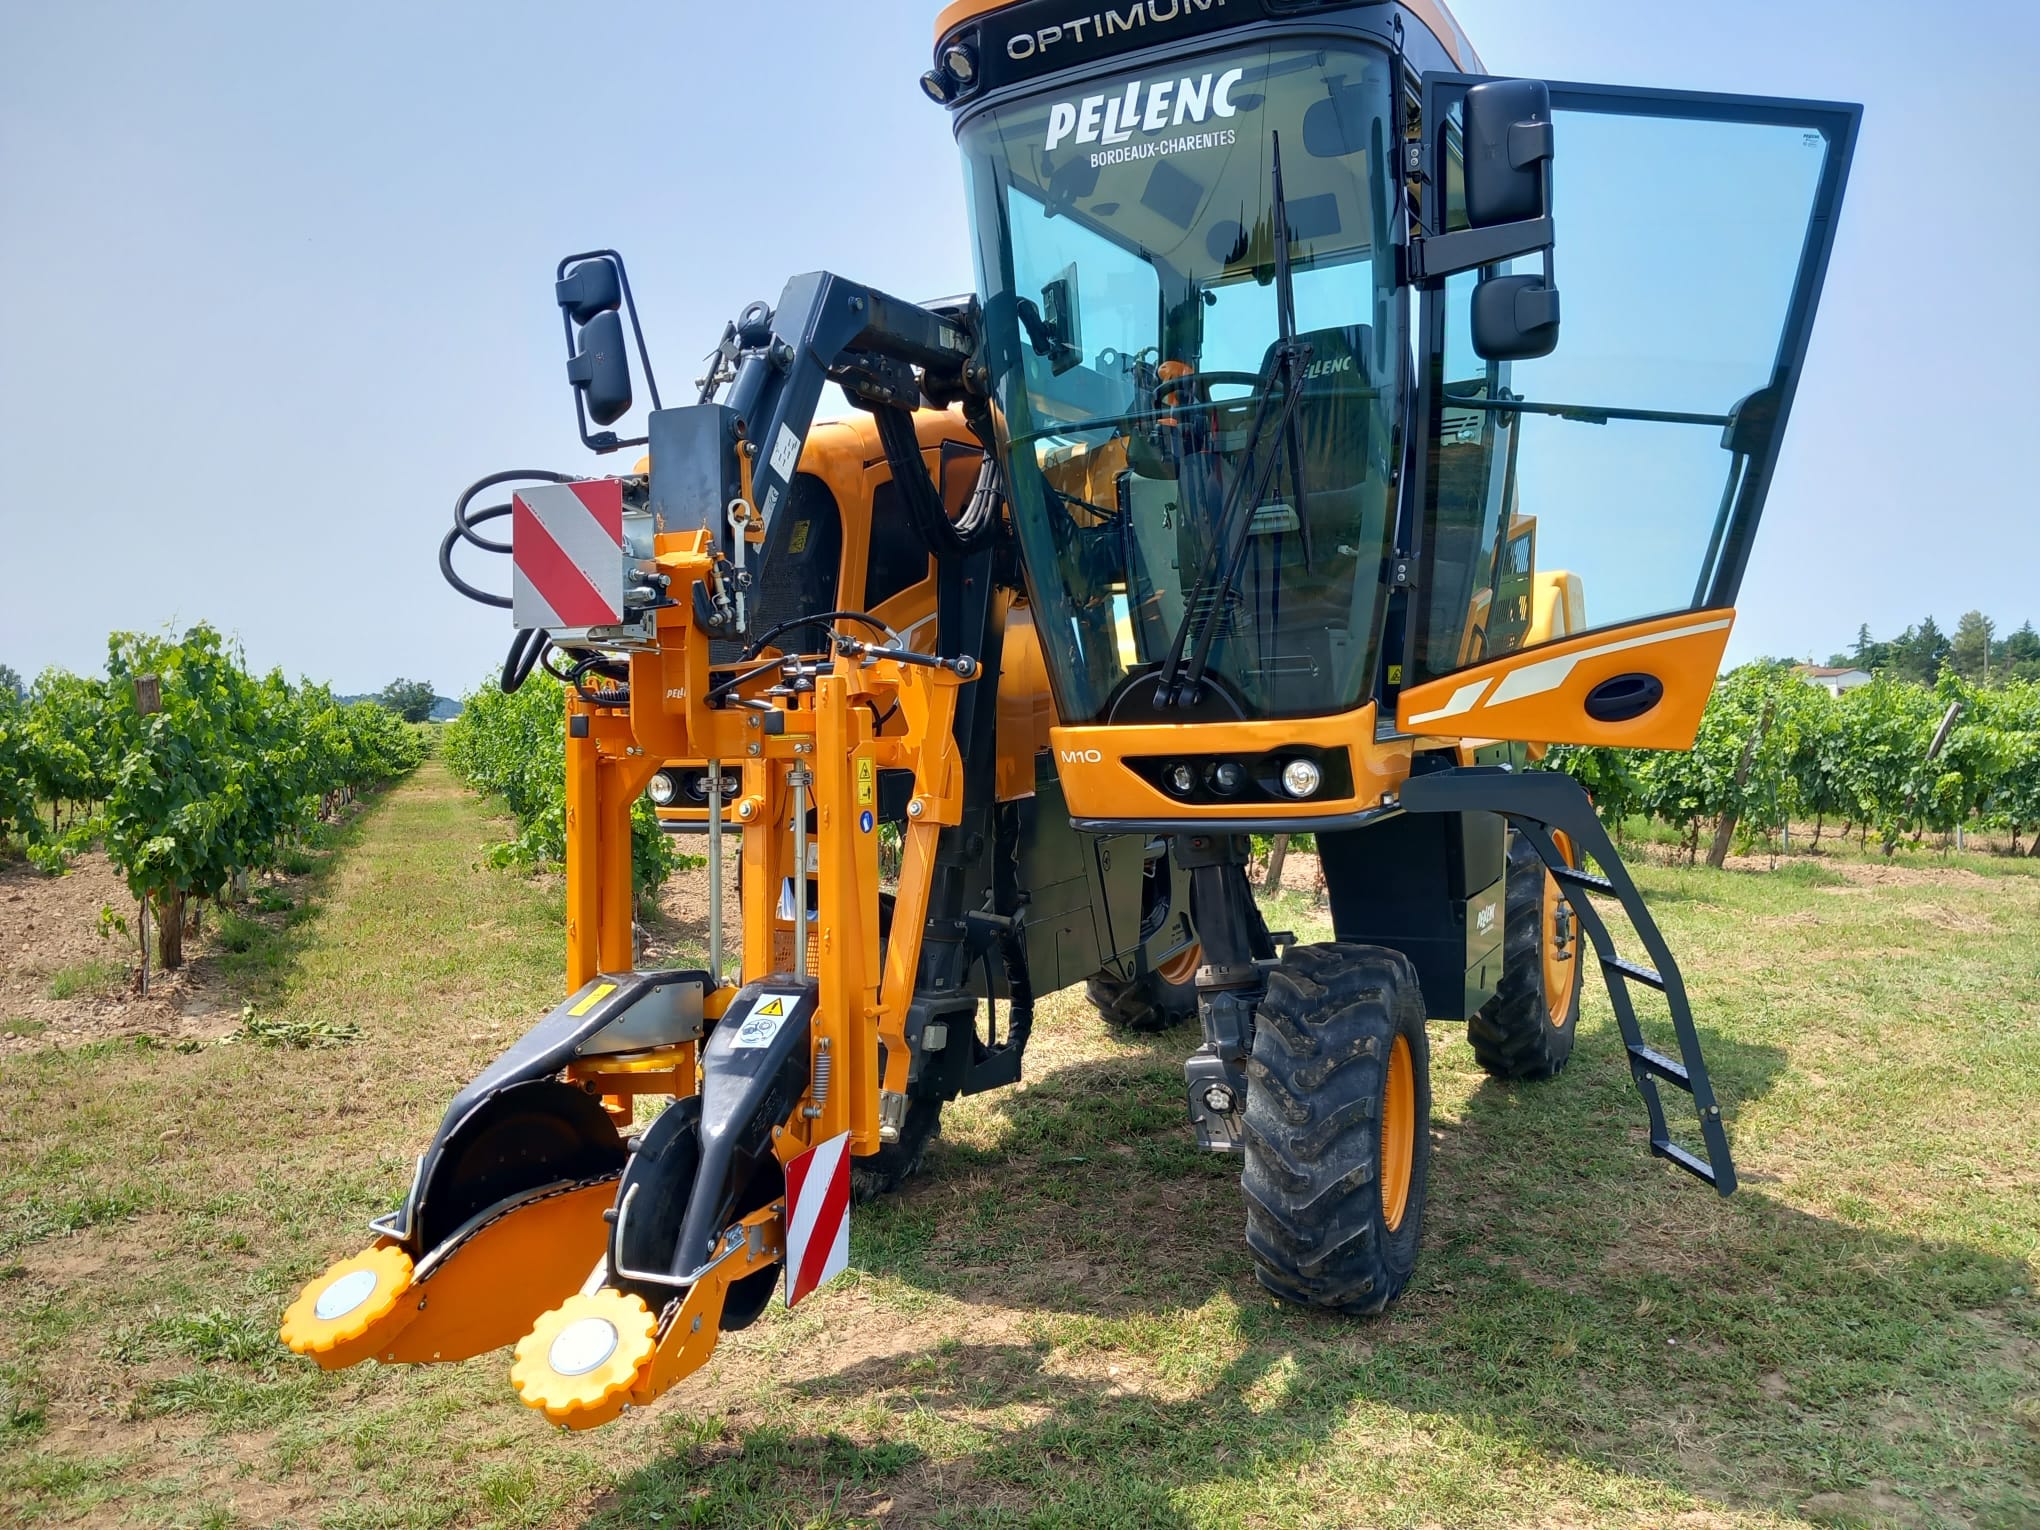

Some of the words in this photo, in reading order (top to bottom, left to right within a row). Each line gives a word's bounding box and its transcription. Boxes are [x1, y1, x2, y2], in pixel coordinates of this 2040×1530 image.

[1045, 68, 1243, 151] PELLENC
[1090, 129, 1236, 168] BORDEAUX-CHARENTES
[666, 687, 686, 699] PELL
[1061, 749, 1102, 763] M10
